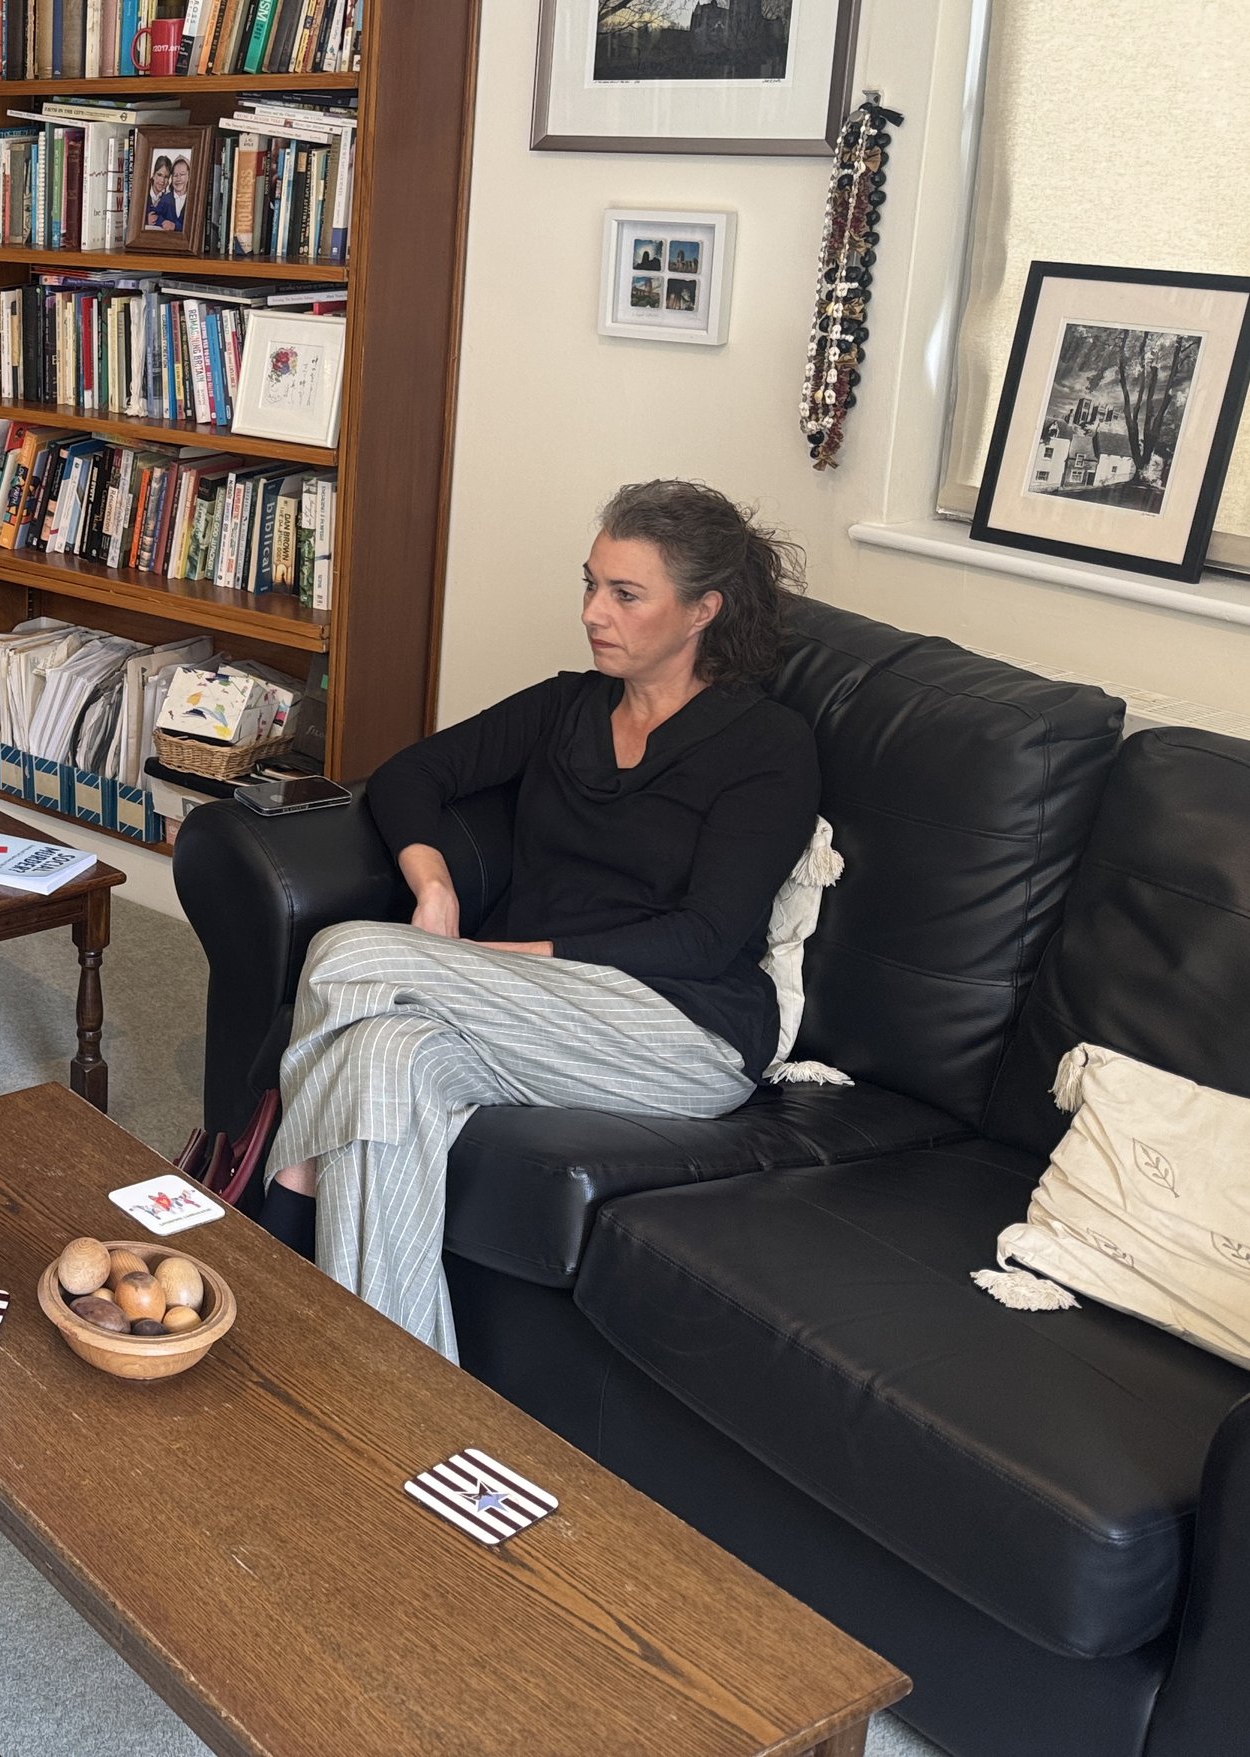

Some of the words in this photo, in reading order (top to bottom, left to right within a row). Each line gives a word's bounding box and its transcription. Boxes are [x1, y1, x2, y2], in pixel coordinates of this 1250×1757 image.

[236, 168, 254, 229] HOLINESS
[188, 309, 200, 354] REIMAGINING
[193, 355, 204, 382] BRITAIN
[104, 489, 118, 532] Resurrection
[261, 502, 274, 572] biblical
[10, 846, 62, 873] MURDER?
[31, 853, 76, 872] SOCIAL
